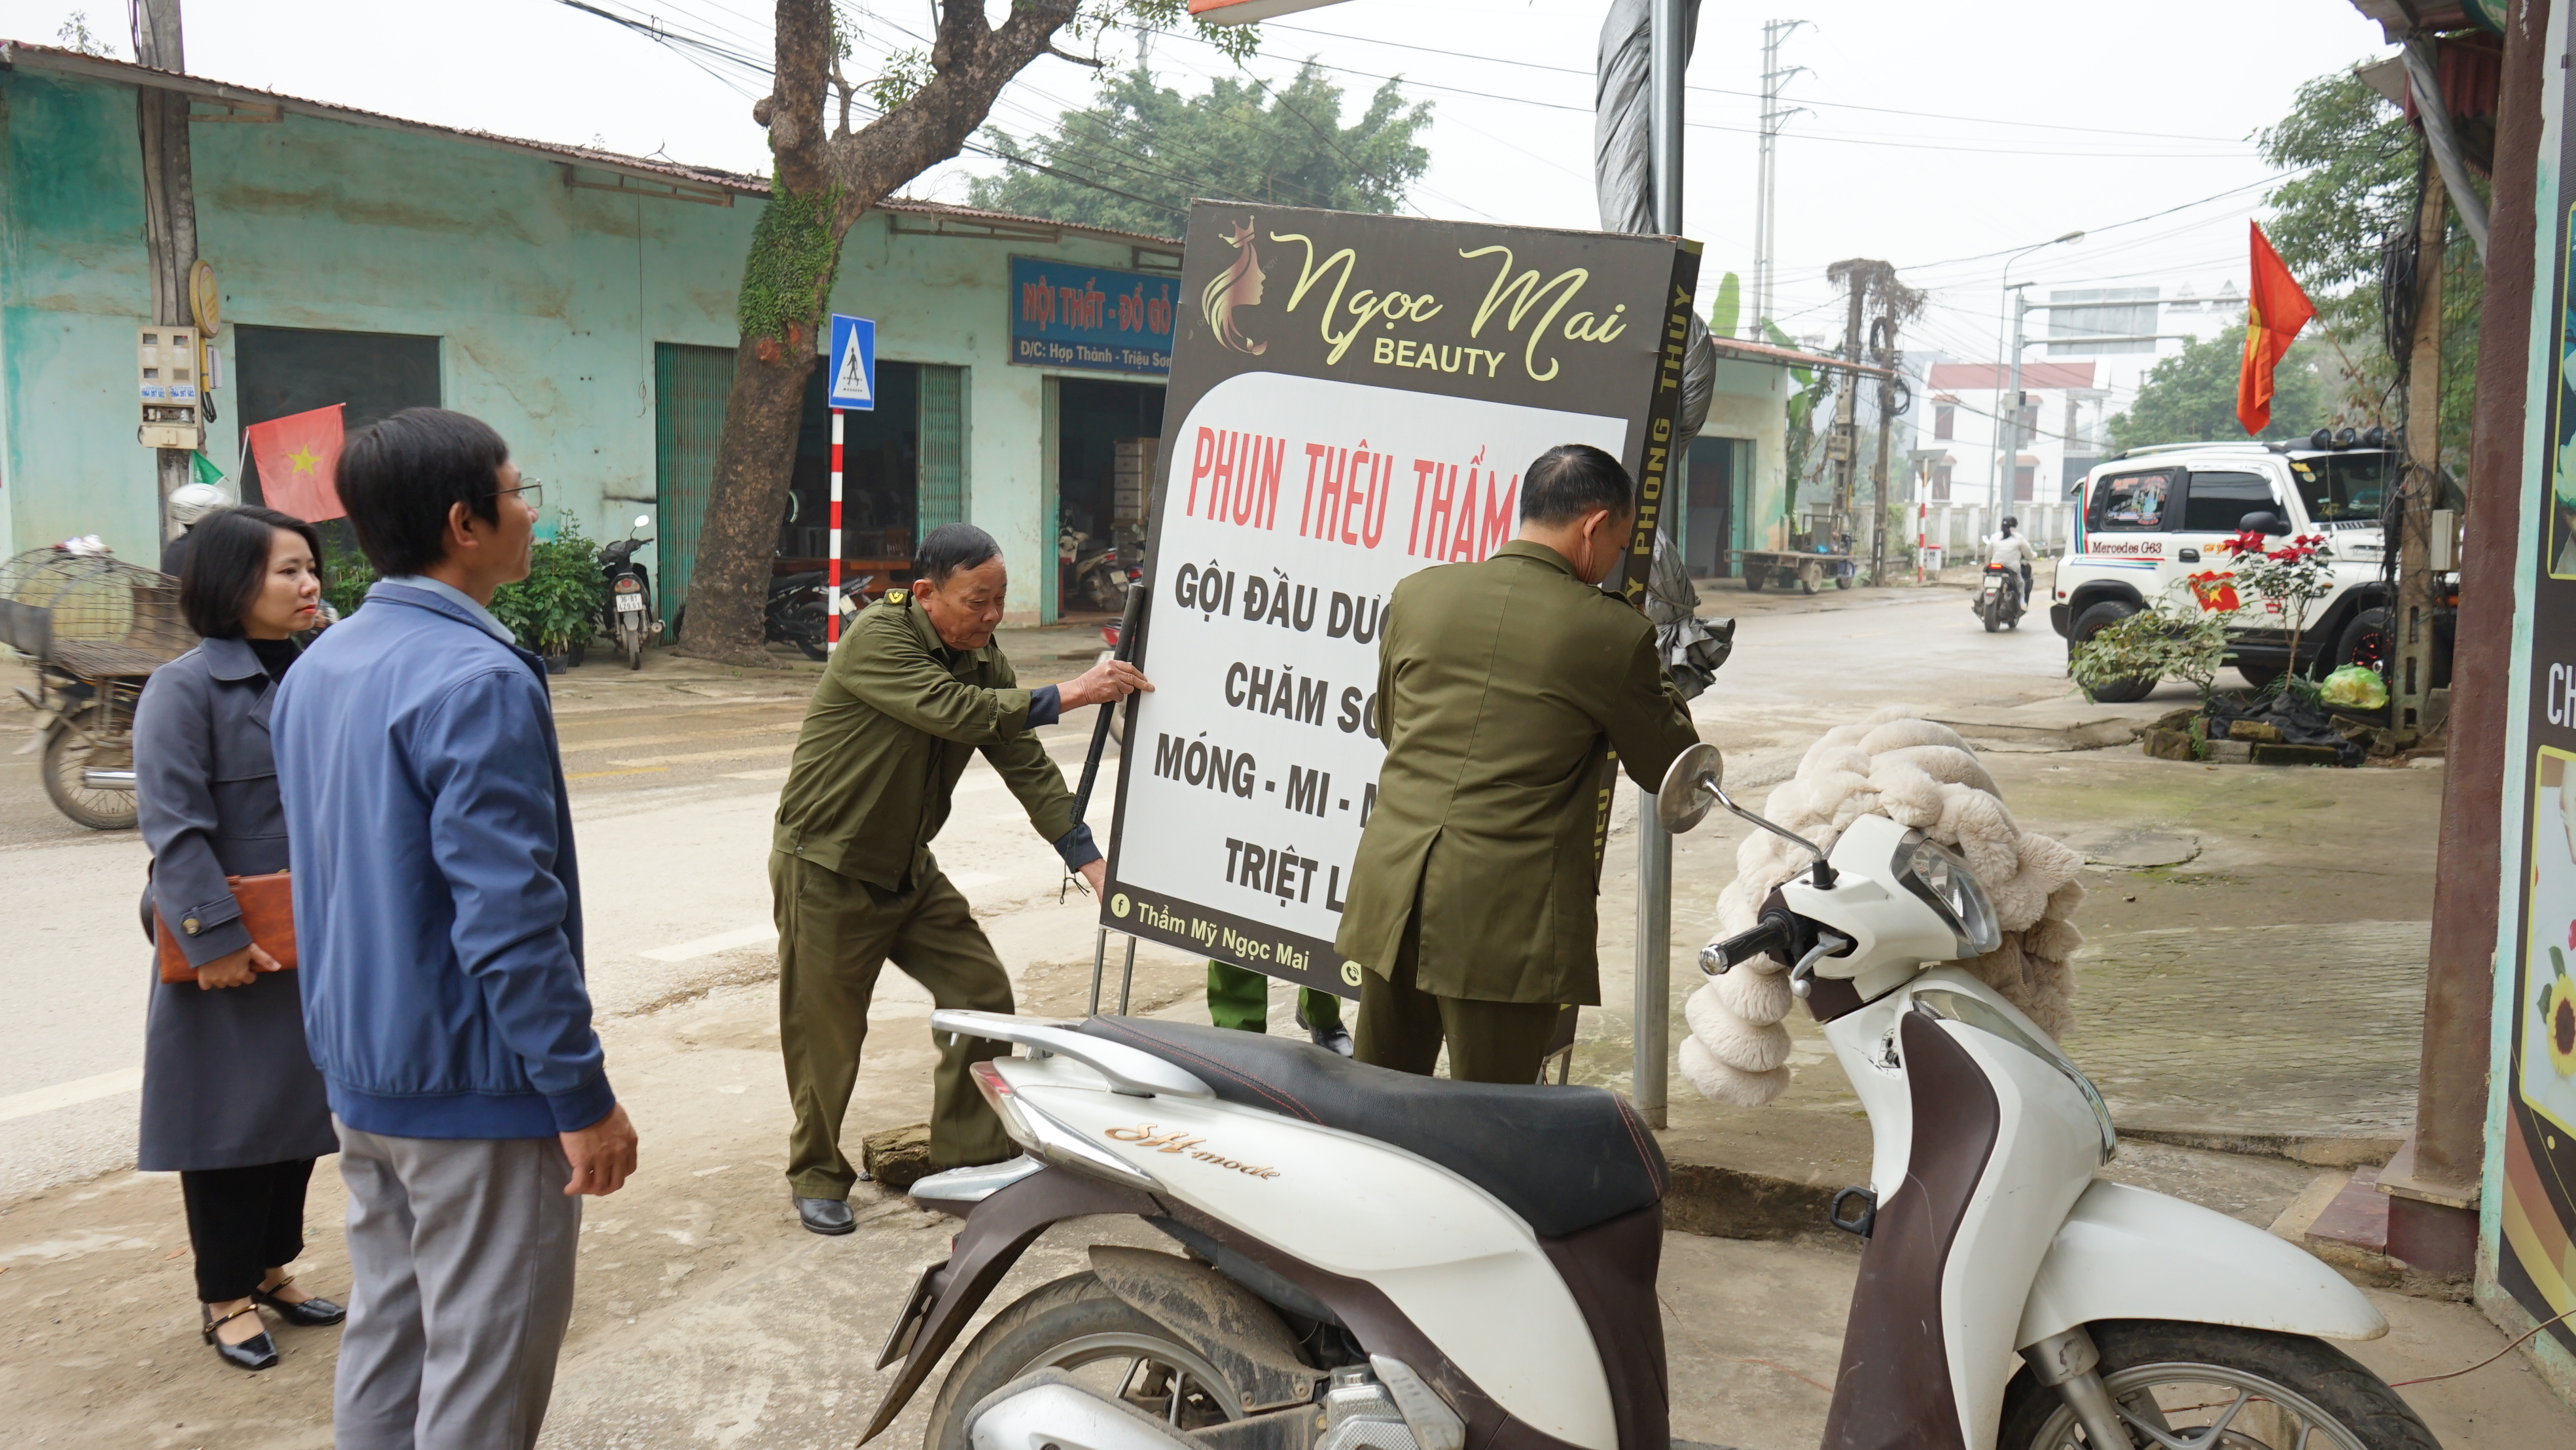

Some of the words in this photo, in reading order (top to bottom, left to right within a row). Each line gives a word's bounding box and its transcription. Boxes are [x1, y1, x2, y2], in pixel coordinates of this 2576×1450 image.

[1023, 275, 1056, 332] NỘI
[1060, 276, 1106, 332] THẤT
[1270, 230, 1443, 366] Ngọc
[1458, 245, 1627, 382] Mai
[1049, 343, 1074, 363] Hợp
[1122, 349, 1149, 370] Triệu
[1374, 338, 1506, 378] BEAUTY
[1186, 426, 1286, 531] PHUN
[1299, 438, 1394, 550] THÊU
[1407, 444, 1518, 563] THẨM
[1634, 418, 1670, 555] PHONG
[2092, 541, 2139, 554] Mercedes
[2140, 541, 2162, 554] G63
[1175, 558, 1235, 622] GỘI
[1243, 566, 1318, 633] ĐẦU
[1225, 662, 1329, 726] CHĂM
[1154, 731, 1256, 800] MÓNG
[1285, 764, 1331, 818] MI
[1225, 837, 1318, 908] TRIỆT
[1137, 904, 1186, 935] Thẩm
[1190, 917, 1218, 948] Mỹ
[1221, 927, 1271, 961] Ngọc
[1276, 942, 1310, 972] Mai
[1103, 1122, 1207, 1154] SH
[1190, 1150, 1281, 1180] mode
